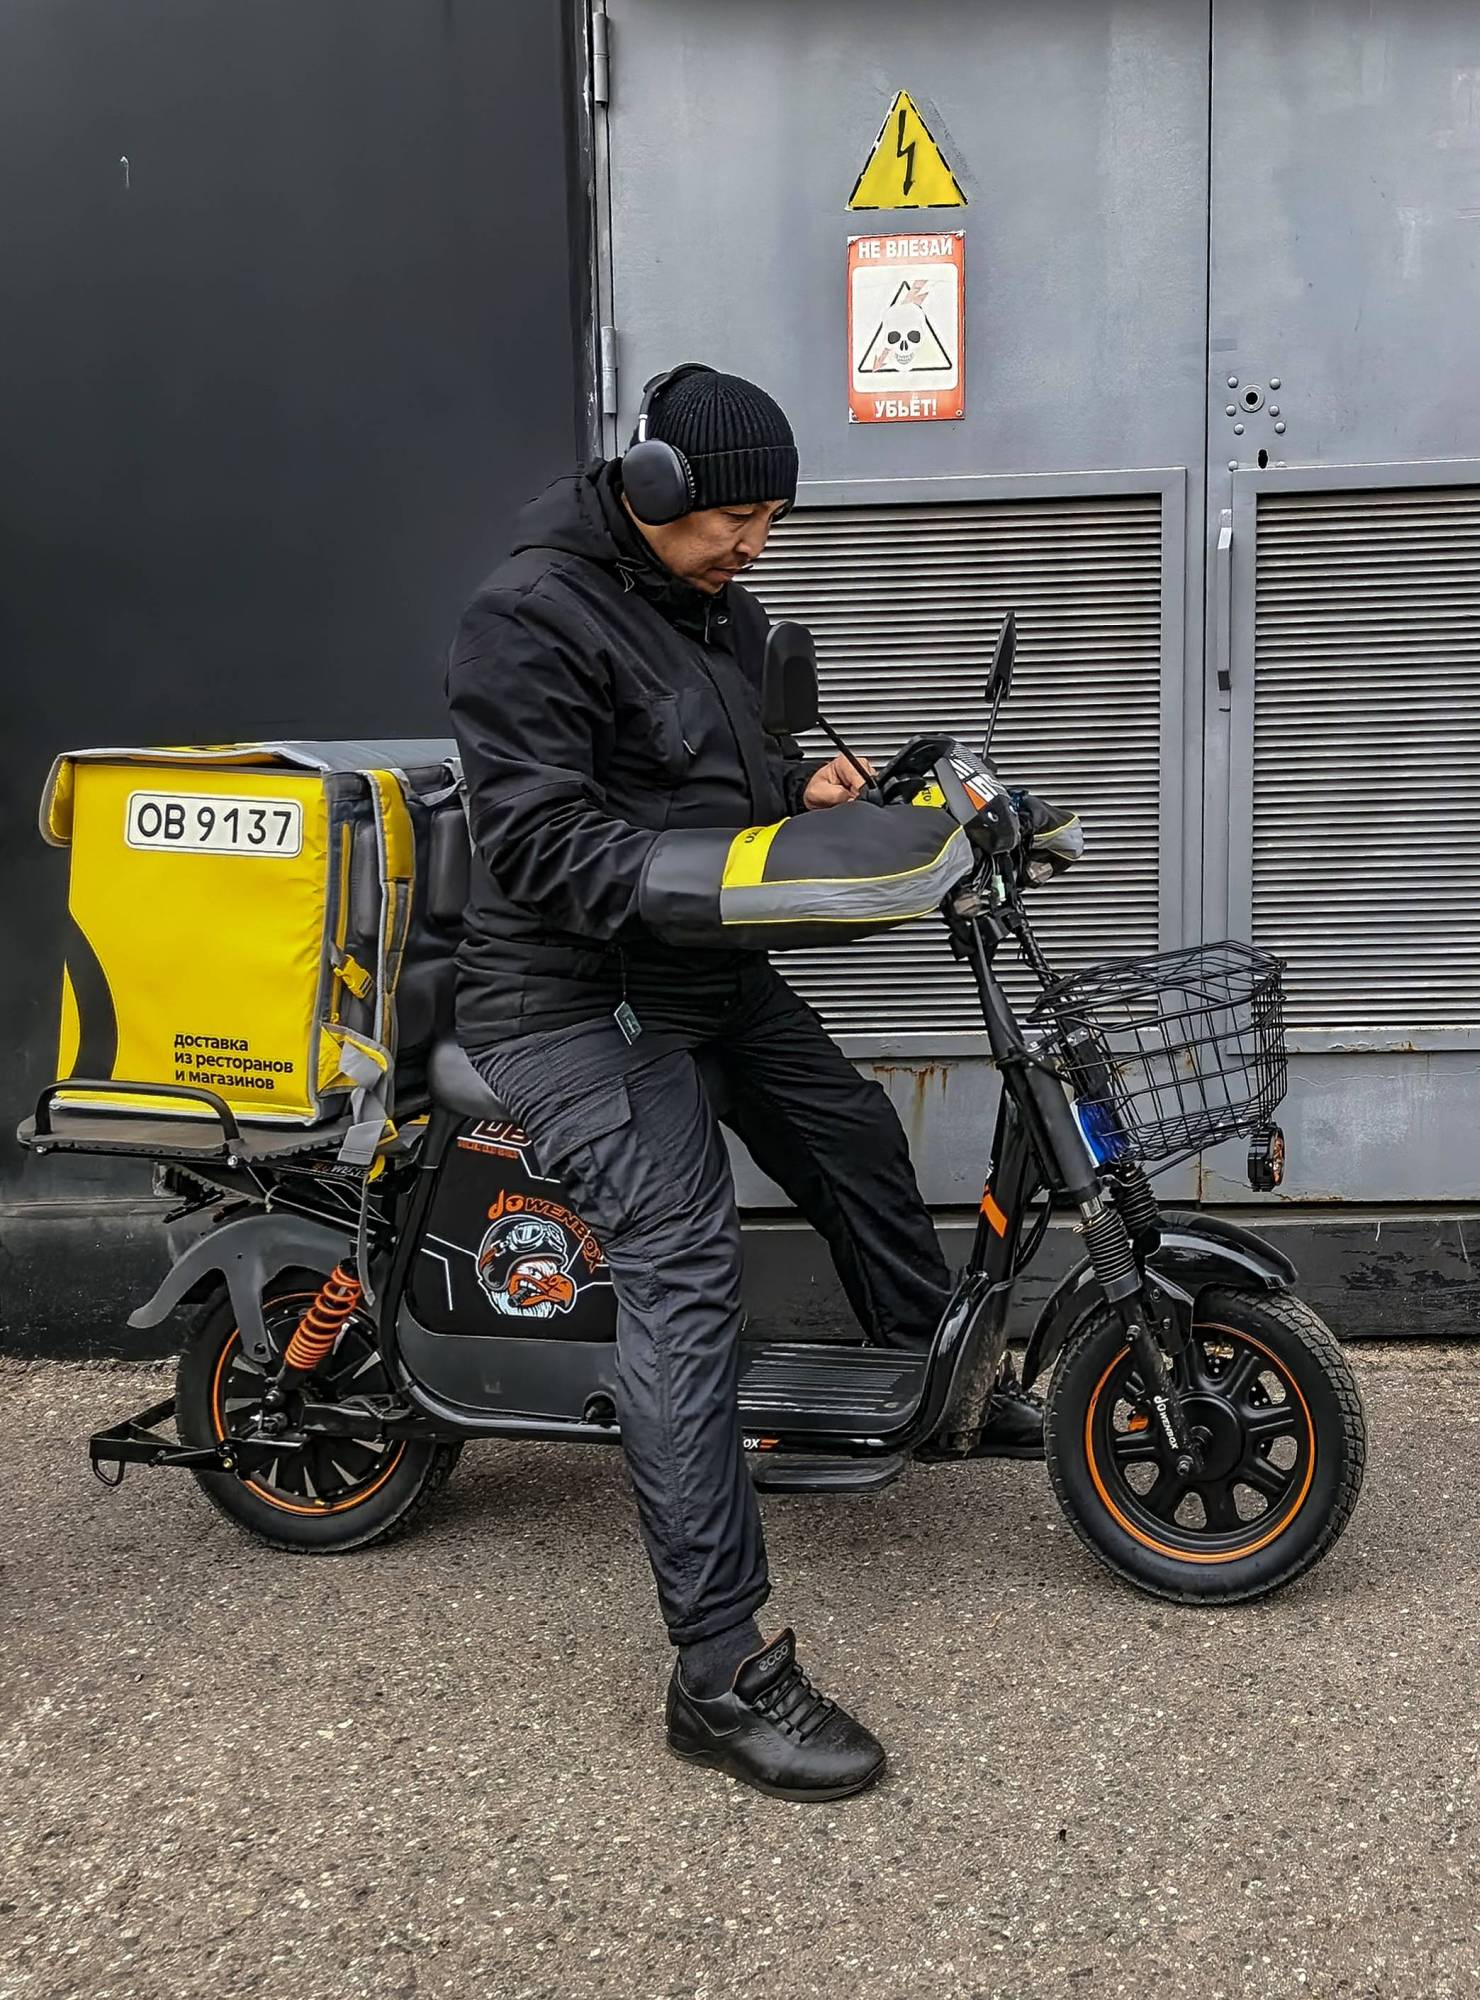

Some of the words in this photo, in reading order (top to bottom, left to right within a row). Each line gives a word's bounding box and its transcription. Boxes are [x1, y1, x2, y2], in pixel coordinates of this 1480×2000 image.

[858, 240, 881, 259] НЕ
[886, 235, 954, 257] ВЛЕЗАЙ
[874, 394, 938, 418] УБЬЁТ!
[196, 806, 292, 846] 9137
[174, 1034, 248, 1051] доставка
[174, 1052, 193, 1065] из
[195, 1053, 294, 1073] ресторанов
[175, 1070, 185, 1081] и
[188, 1070, 275, 1090] магазинов
[758, 1644, 789, 1672] ecco
